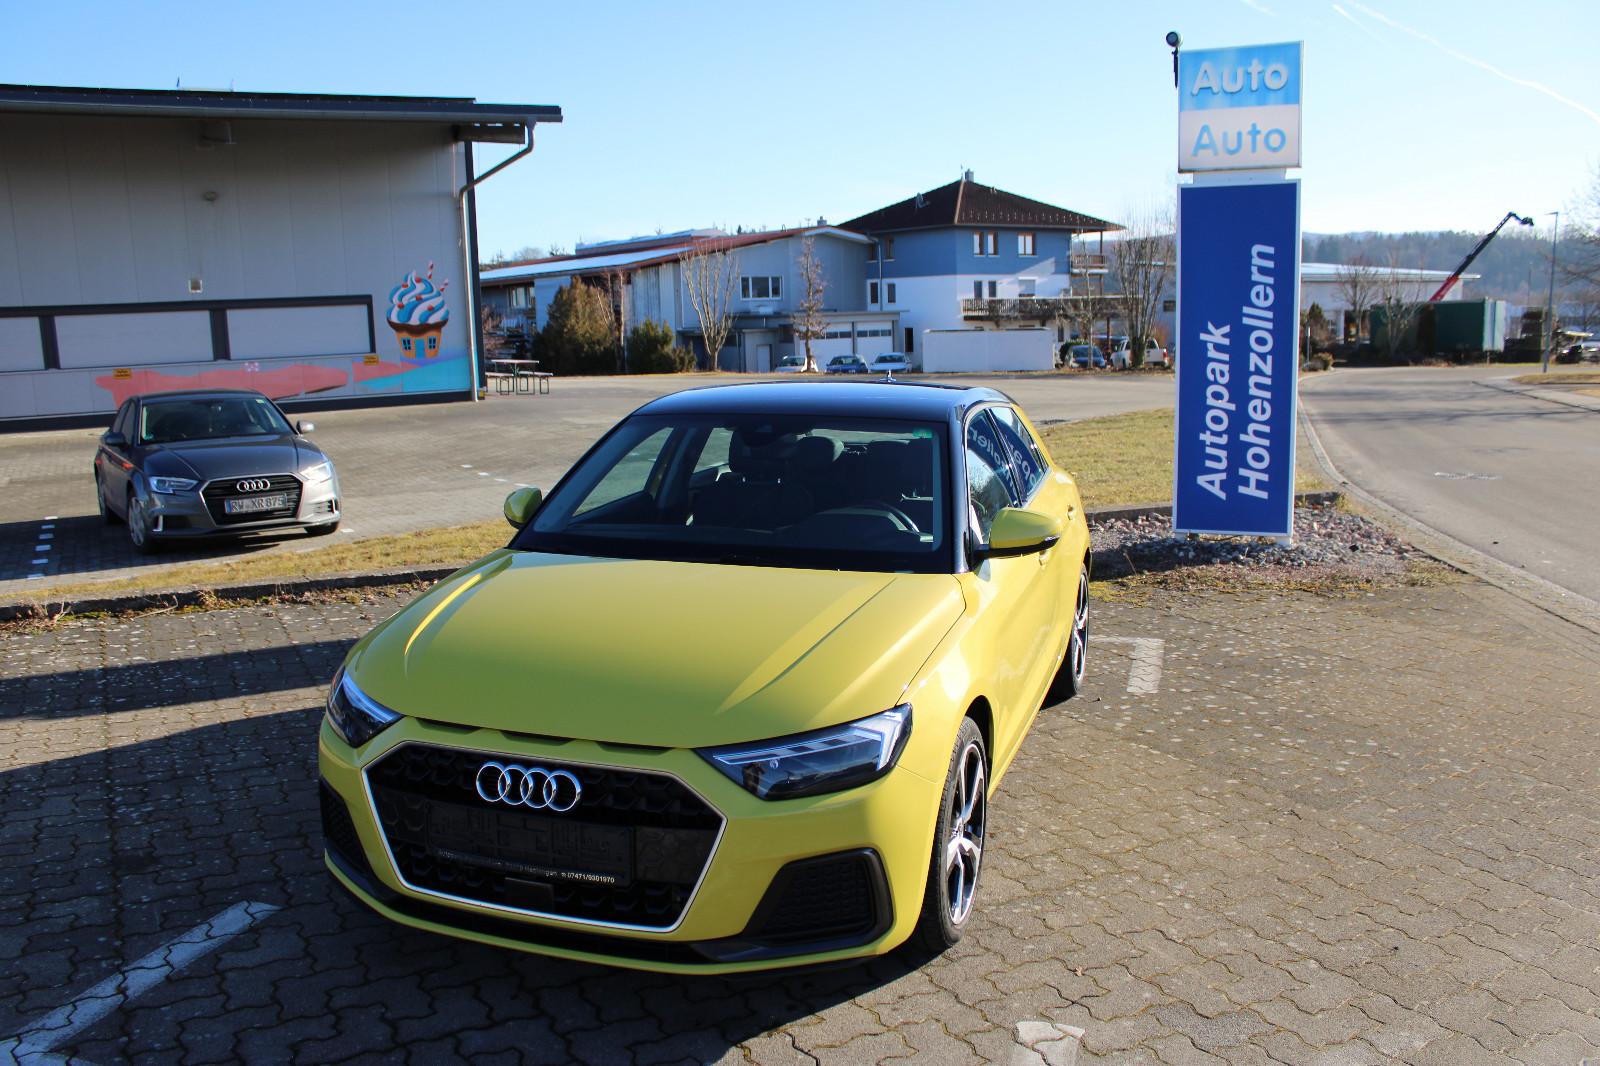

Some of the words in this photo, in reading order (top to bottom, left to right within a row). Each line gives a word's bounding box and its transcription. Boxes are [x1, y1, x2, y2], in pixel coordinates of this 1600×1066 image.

[1191, 60, 1288, 96] Auto
[1191, 123, 1286, 157] Auto
[1197, 321, 1236, 500] Autopark
[1238, 244, 1275, 499] Hohenzollern
